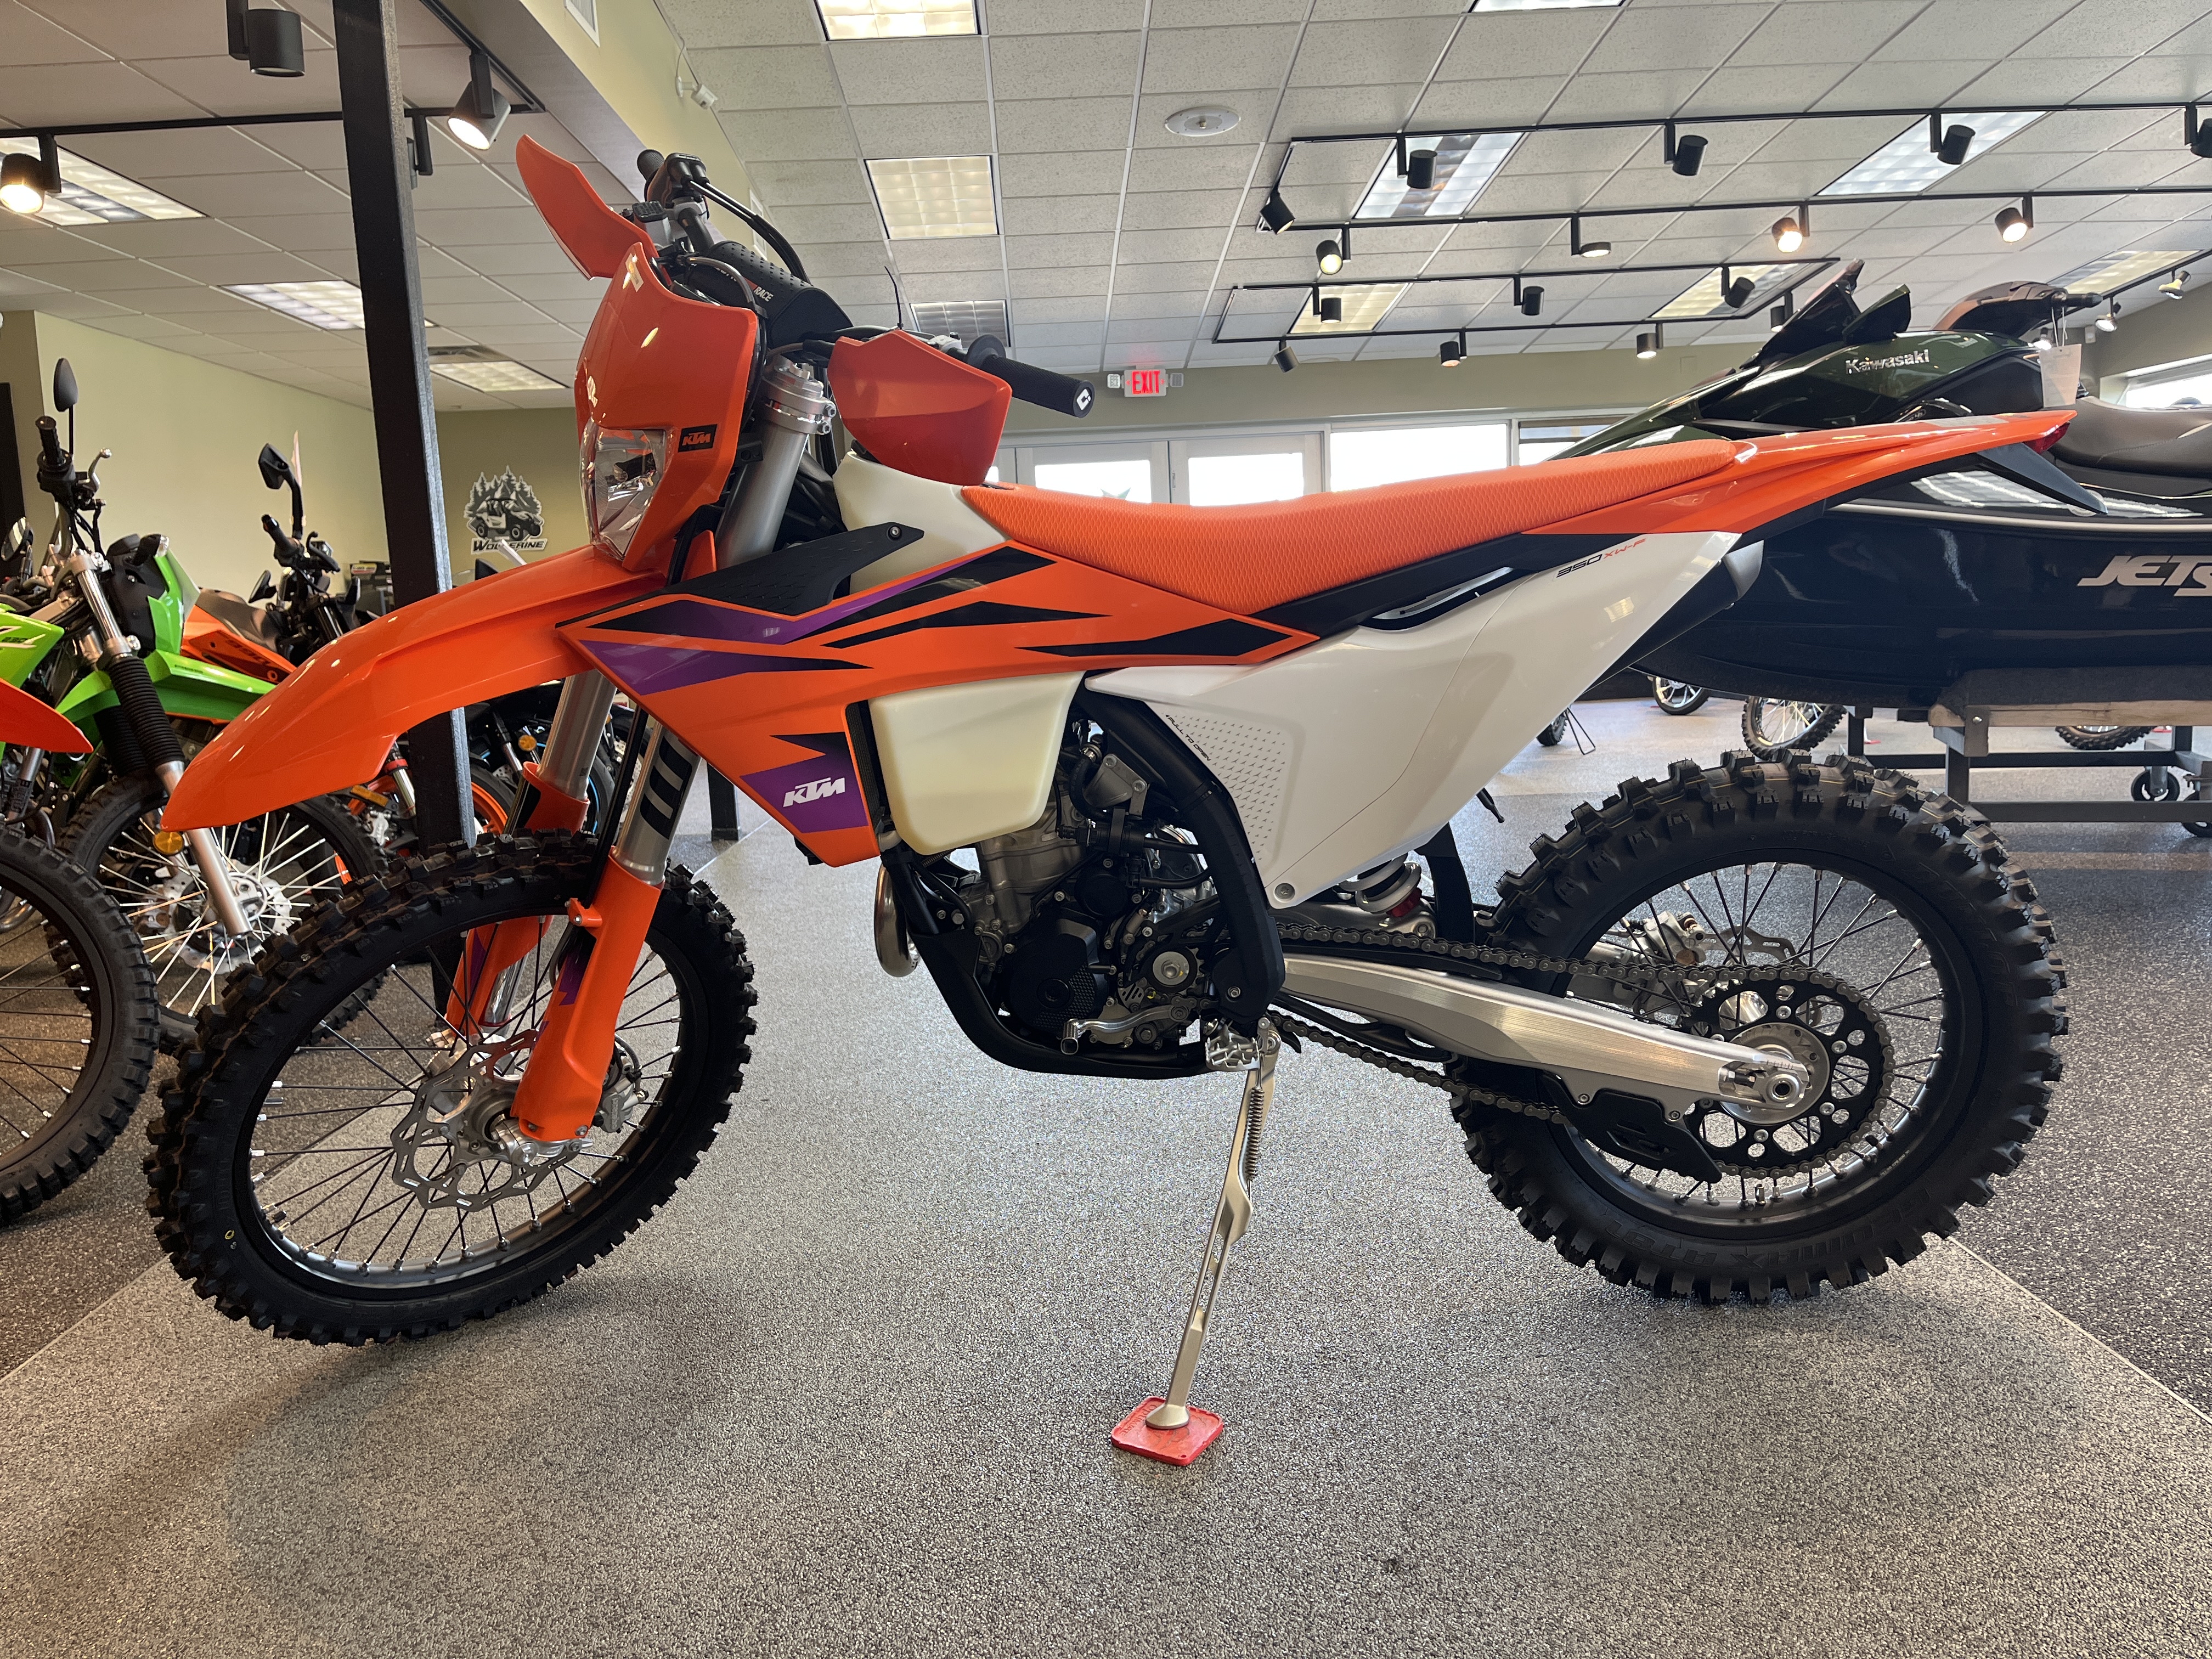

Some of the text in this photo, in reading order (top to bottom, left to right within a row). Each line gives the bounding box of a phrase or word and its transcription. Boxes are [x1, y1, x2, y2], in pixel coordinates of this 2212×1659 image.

[753, 286, 774, 302] RACE
[1845, 349, 1930, 374] Kawasaki
[1132, 370, 1161, 394] EXIT
[682, 431, 712, 446] KTM
[473, 539, 545, 551] WOLERINE
[1167, 717, 1211, 761] PULL TO OPEN
[783, 777, 845, 808] KTM
